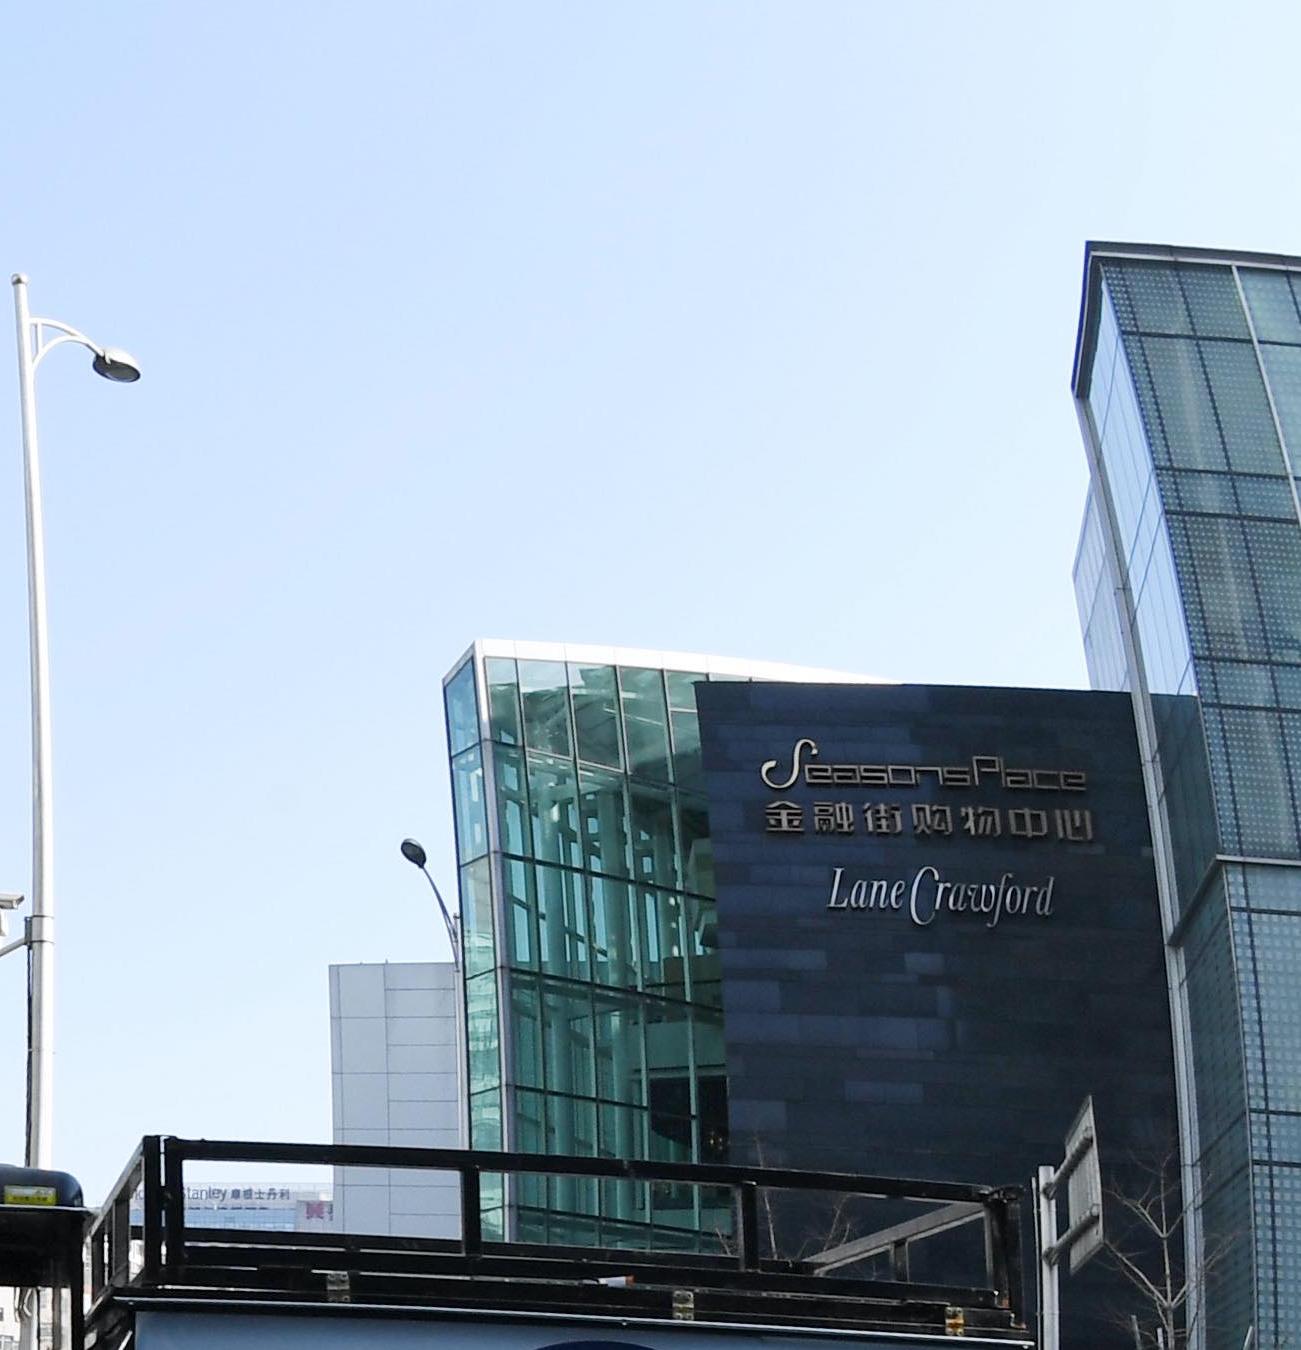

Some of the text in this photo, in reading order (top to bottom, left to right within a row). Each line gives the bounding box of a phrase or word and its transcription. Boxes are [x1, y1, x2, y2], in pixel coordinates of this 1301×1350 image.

[765, 800, 1095, 842] 金融街购物中心
[827, 866, 1056, 928] Lane Crawford
[183, 1187, 227, 1202] tanley
